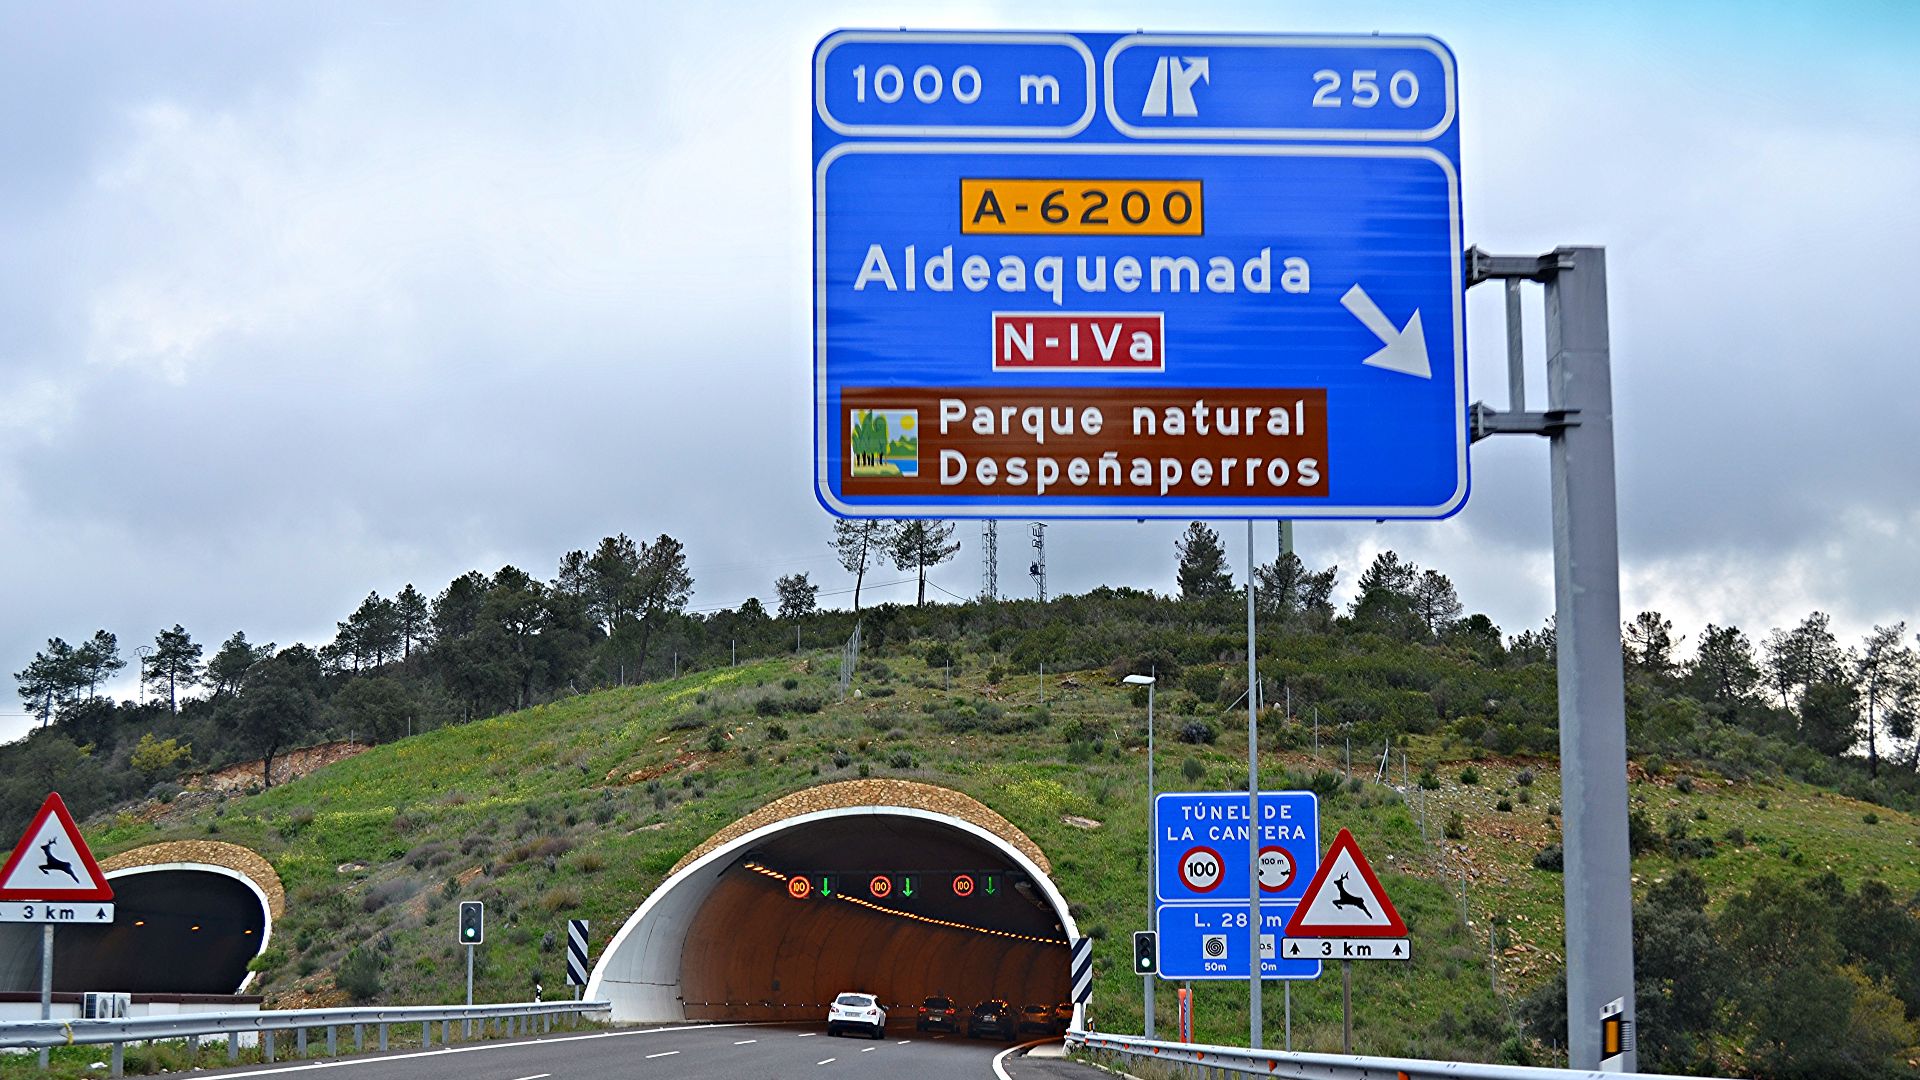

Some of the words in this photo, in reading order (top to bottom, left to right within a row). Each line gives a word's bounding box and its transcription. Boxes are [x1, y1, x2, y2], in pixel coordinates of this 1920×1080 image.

[852, 64, 983, 105] 1000
[1019, 74, 1061, 106] m
[1312, 69, 1420, 109] 250
[972, 190, 1194, 226] A-6200
[853, 243, 1312, 306] Aldeaquemada
[1003, 322, 1154, 363] N-IVa
[938, 399, 1104, 444] Parque
[1133, 399, 1306, 436] natural
[938, 450, 1321, 496] Despeñaperros
[1182, 802, 1250, 820] TÚNEL
[1264, 805, 1292, 819] DE
[1167, 826, 1194, 840] LA
[1187, 861, 1217, 877] 100
[793, 882, 806, 892] 100
[874, 882, 888, 892] 100
[957, 881, 970, 890] 100
[23, 905, 34, 919] 3
[46, 905, 74, 919] km
[1194, 912, 1211, 928] L.
[1321, 942, 1332, 956] 3
[1343, 941, 1372, 956] km
[1204, 962, 1227, 972] 50m
